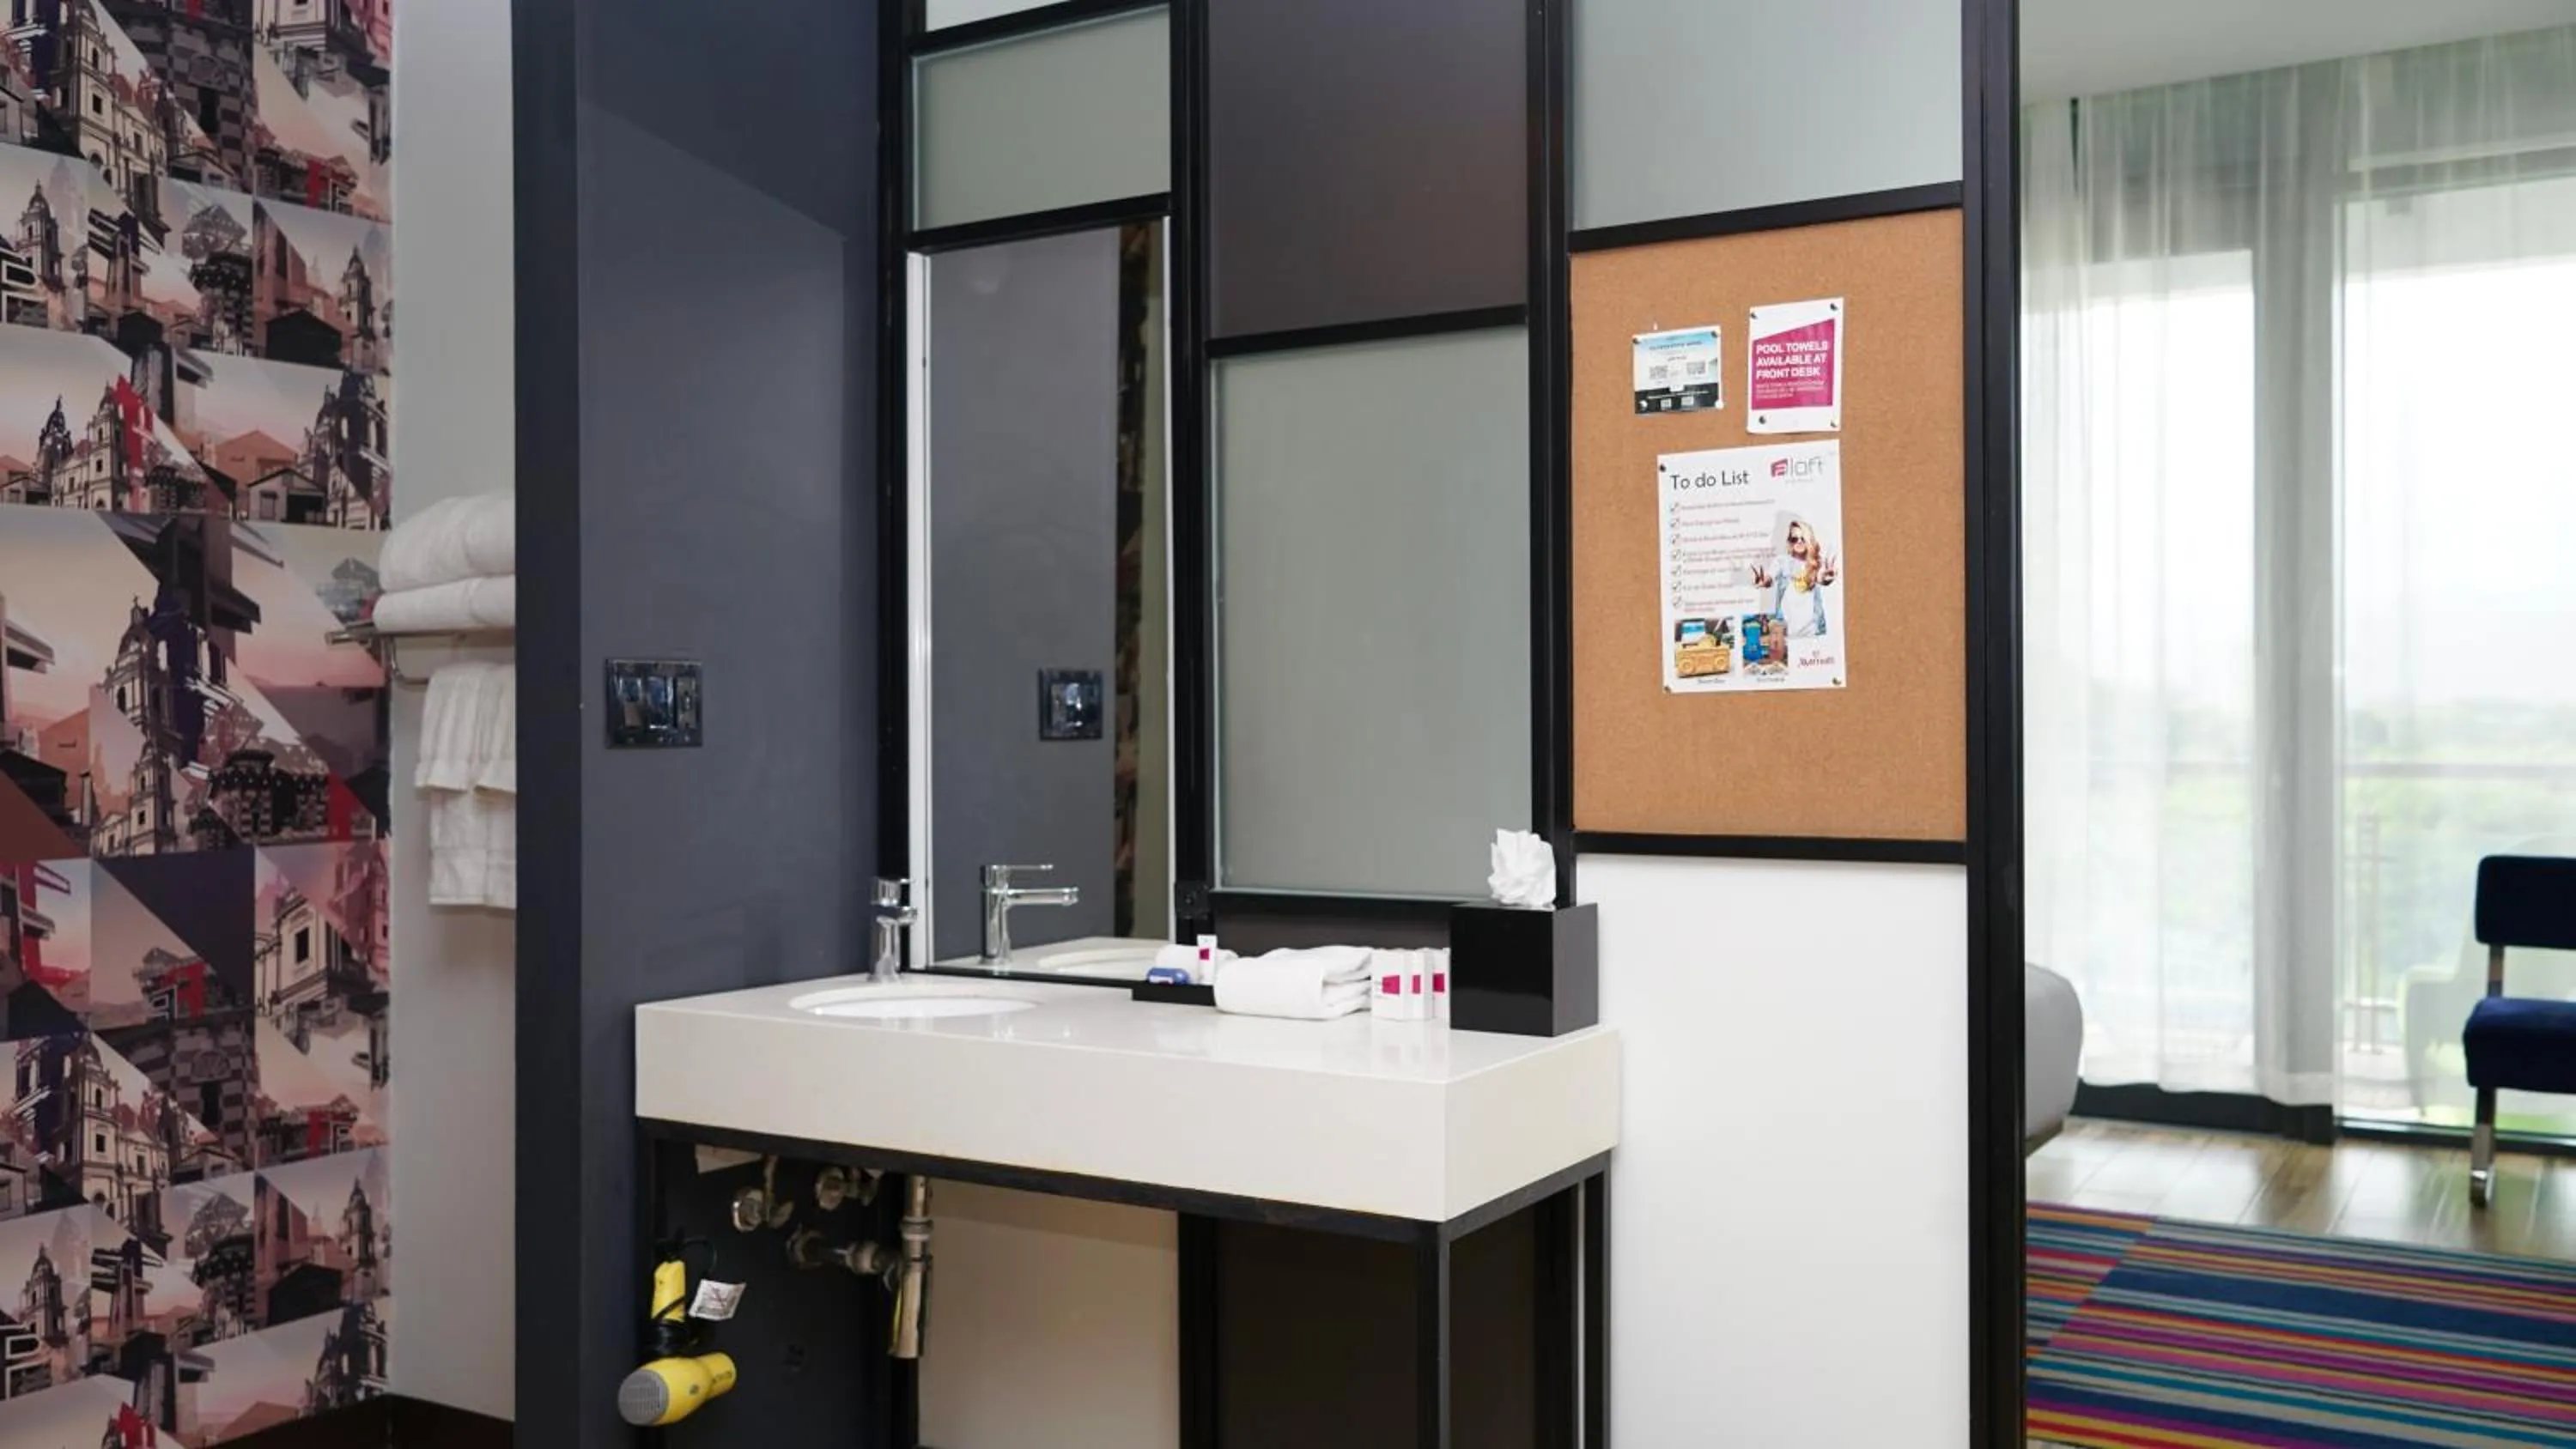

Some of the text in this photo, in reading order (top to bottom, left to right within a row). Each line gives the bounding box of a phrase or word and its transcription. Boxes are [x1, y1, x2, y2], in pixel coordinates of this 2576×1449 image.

[1756, 341, 1828, 355] POOL TOWELS
[1756, 353, 1827, 367] AVAILABLE AT
[1756, 367, 1821, 379] FRONT DESK
[1669, 470, 1752, 490] To do List
